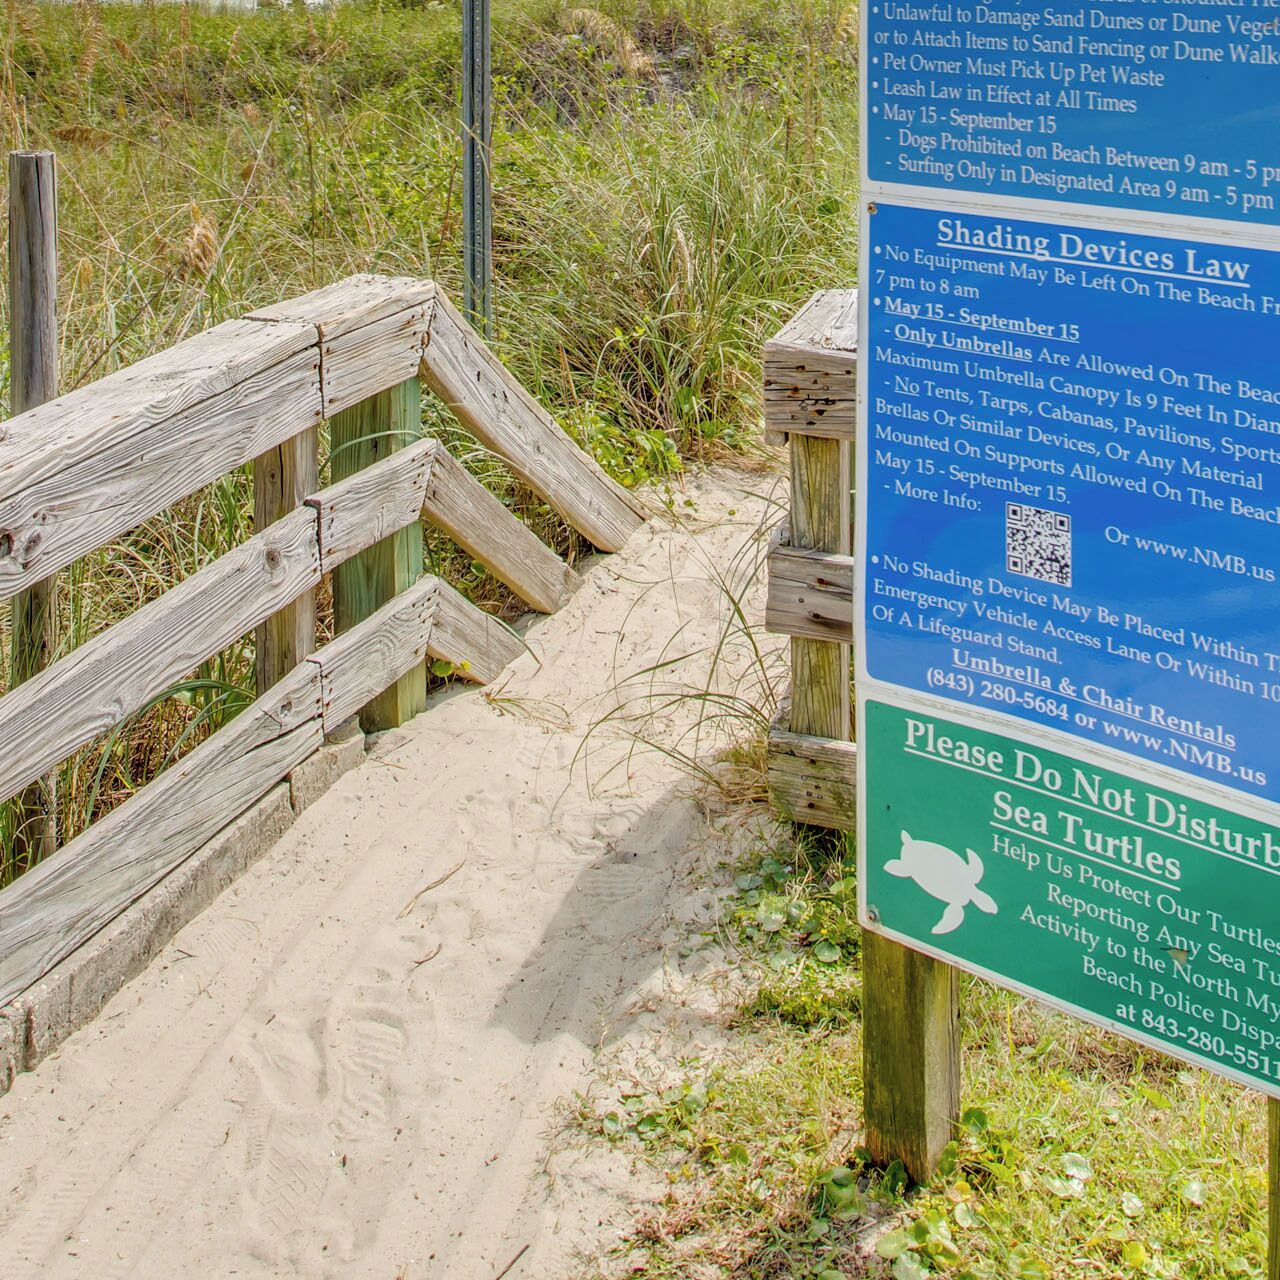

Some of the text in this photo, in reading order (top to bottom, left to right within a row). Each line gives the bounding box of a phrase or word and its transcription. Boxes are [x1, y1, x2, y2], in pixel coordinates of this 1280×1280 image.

[882, 51, 1165, 87] Pet Owner Must Pick Up Pet Waste
[883, 76, 1137, 113] Leash Law in Effect at All Times
[884, 243, 909, 262] No
[913, 247, 1005, 276] Equipment
[1009, 260, 1048, 286] May
[1053, 266, 1075, 285] Be
[1080, 270, 1116, 291] Left
[1120, 276, 1150, 296] On
[1154, 280, 1192, 302] The
[1197, 286, 1255, 312] Beach
[937, 218, 1250, 280] Shading Devices Law
[875, 345, 959, 374] Maximum
[963, 360, 1044, 389] Umbrella
[1048, 375, 1120, 408] Canopy
[1125, 388, 1142, 407] Is
[1145, 392, 1158, 409] 9
[1162, 395, 1202, 419] Feet
[1207, 403, 1228, 424] In
[893, 323, 937, 348] Only
[941, 330, 1032, 362] Umbrellas
[1037, 347, 1070, 366] Are
[1075, 353, 1154, 381] Allowed
[1158, 366, 1189, 388] On
[1193, 372, 1232, 395] The
[875, 397, 1262, 489] Brellas Or Similar Devices, Or Any Material
[893, 374, 920, 397] No
[922, 379, 974, 405] Tents,
[977, 389, 1033, 416] Tarps,
[1036, 400, 1118, 433] Cabanas,
[1123, 416, 1216, 453] Pavilions,
[875, 423, 949, 452] Mounted
[953, 438, 981, 458] On
[984, 444, 1065, 475] Supports
[1069, 462, 1147, 494] Allowed
[1151, 480, 1182, 502] On
[1186, 486, 1224, 511] The
[1104, 525, 1275, 582] Or www.NMB.us
[873, 577, 967, 617] Emergency
[973, 601, 1038, 631] Vehicle
[1041, 620, 1101, 649] Access
[1106, 635, 1151, 664] Lane
[1154, 651, 1182, 673] Or
[1185, 658, 1255, 695] Within
[883, 553, 909, 573] No
[912, 561, 984, 596] Shading
[988, 578, 1047, 607] Device
[1051, 594, 1092, 623] May
[1096, 605, 1119, 627] Be
[1123, 612, 1185, 646] Placed
[1190, 631, 1260, 667] Within
[926, 666, 1266, 785] (843) 280-5684 or www.NMB.us
[951, 647, 1237, 749] Umbrella & Chair Rentals
[904, 717, 1005, 773] Please
[1014, 748, 1063, 791] Do
[1072, 768, 1137, 818] Not
[991, 832, 1041, 871] Help
[1045, 851, 1073, 878] Us
[1077, 863, 1151, 907] Protect
[1155, 893, 1201, 924] Our
[992, 790, 1181, 880] Sea Turtles
[1018, 903, 1100, 953] Activity
[1105, 936, 1127, 958] to
[1132, 946, 1166, 973] the
[1171, 955, 1239, 1002] North
[1046, 881, 1149, 943] Reporting
[1154, 924, 1201, 960] Any
[1207, 942, 1245, 973] Sea
[1081, 954, 1143, 996] Beach
[1149, 980, 1214, 1023] Police
[1115, 1003, 1136, 1022] at
